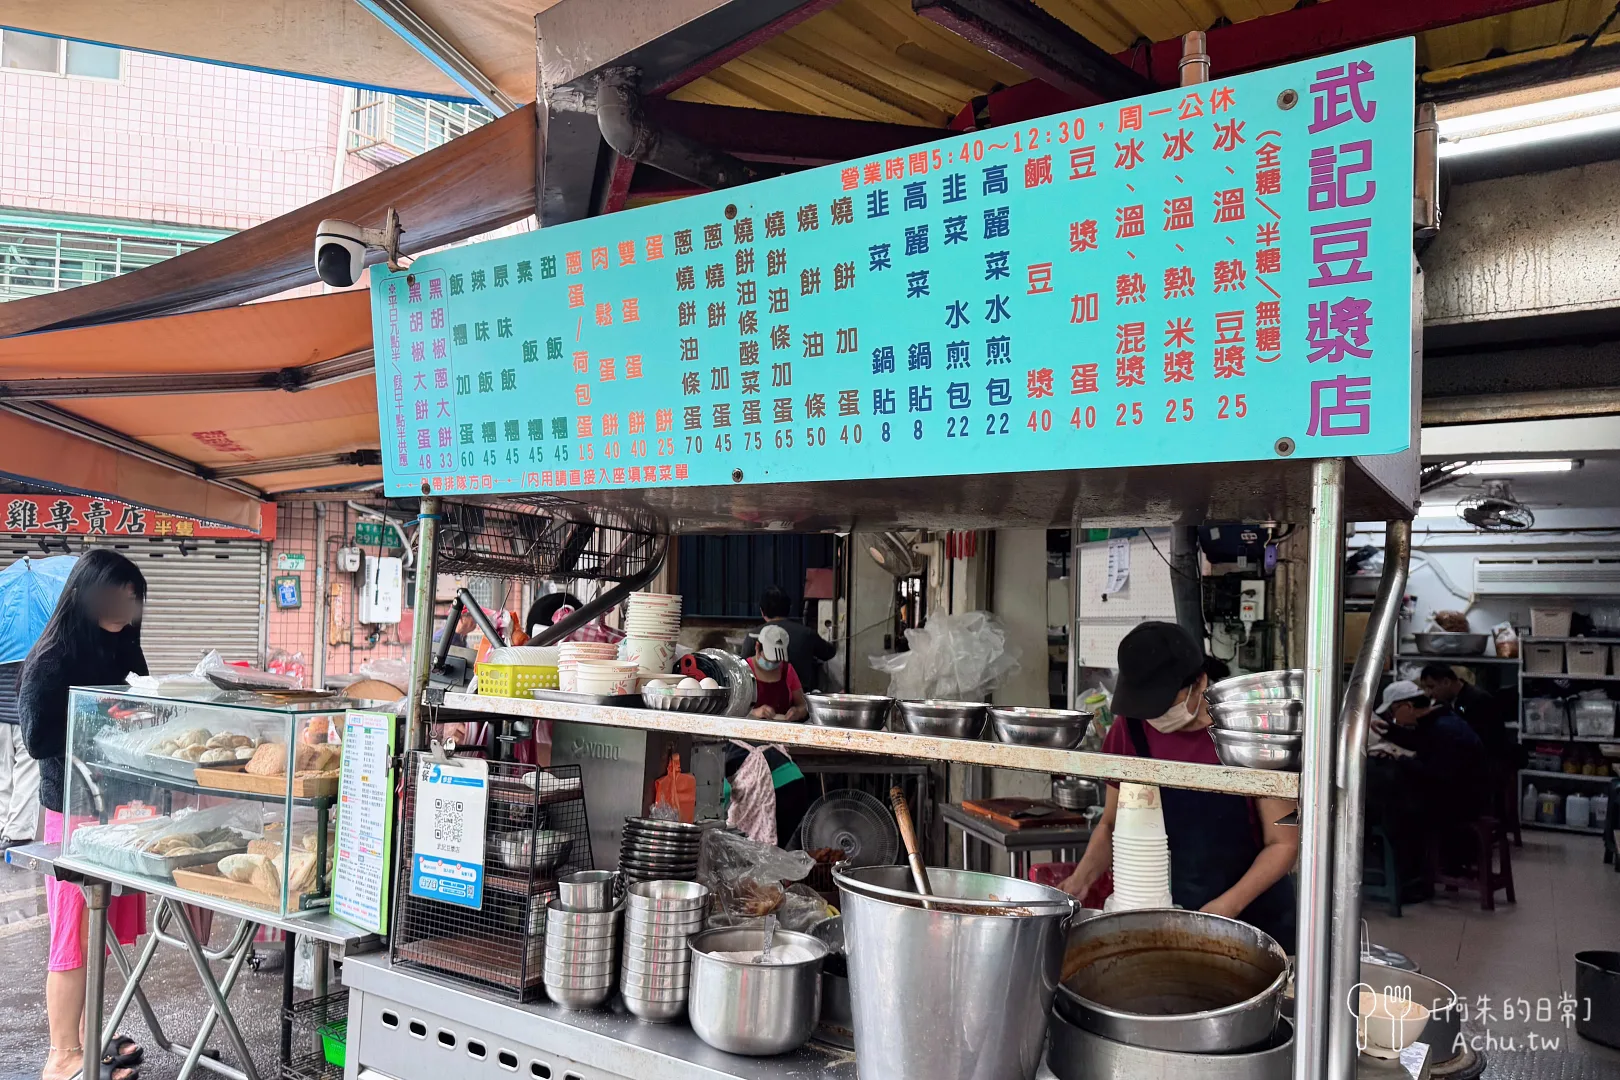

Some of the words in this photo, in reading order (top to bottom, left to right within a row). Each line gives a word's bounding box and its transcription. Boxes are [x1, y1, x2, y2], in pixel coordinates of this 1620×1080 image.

[1306, 60, 1377, 438] 武記豆漿店
[1024, 154, 1054, 399] 鹹豆漿
[1069, 145, 1099, 395] 豆漿加蛋
[903, 180, 933, 413] 高麗菜鍋貼
[942, 173, 972, 410] 韭菜水煎包
[982, 164, 1012, 407] 高麗菜水煎包
[796, 203, 827, 420] 燒餅油條
[830, 196, 861, 417] 燒餅加蛋
[867, 189, 896, 416] 韭菜鍋貼
[733, 217, 762, 425] 燒餅油條酸菜蛋
[764, 210, 793, 424] 燒餅油條加蛋
[591, 247, 619, 436] 肉鬆蛋餅
[645, 234, 673, 432] 蛋餅
[449, 274, 474, 445] 飯糰加蛋
[471, 269, 497, 443] 辣味飯糰
[494, 264, 520, 442] 原味飯糰
[516, 260, 543, 442] 素飯糰
[541, 255, 568, 440] 甜飯糰
[617, 240, 645, 435] 雙蛋蛋餅
[631, 439, 647, 457] 40
[408, 281, 431, 449] 黑胡椒大餅蛋
[1070, 405, 1096, 429] 40
[1116, 402, 1143, 426] 25
[1165, 398, 1194, 422] 25
[1217, 394, 1247, 419] 25
[881, 421, 891, 442] 8
[913, 419, 923, 440] 8
[946, 416, 969, 438] 22
[986, 412, 1009, 435] 22
[1027, 409, 1052, 432] 40
[685, 435, 703, 454] 70
[714, 433, 732, 452] 45
[744, 431, 762, 450] 75
[774, 429, 794, 449] 65
[806, 427, 826, 447] 50
[840, 424, 862, 444] 40
[483, 450, 496, 466] 45
[506, 448, 520, 465] 45
[529, 446, 543, 463] 45
[554, 445, 568, 462] 45
[579, 444, 594, 461] 15
[604, 441, 620, 459] 40
[658, 437, 674, 456] 25
[419, 454, 432, 470] 48
[440, 453, 453, 468] 33
[461, 451, 474, 467] 60
[5, 499, 147, 535] 雞專賣店
